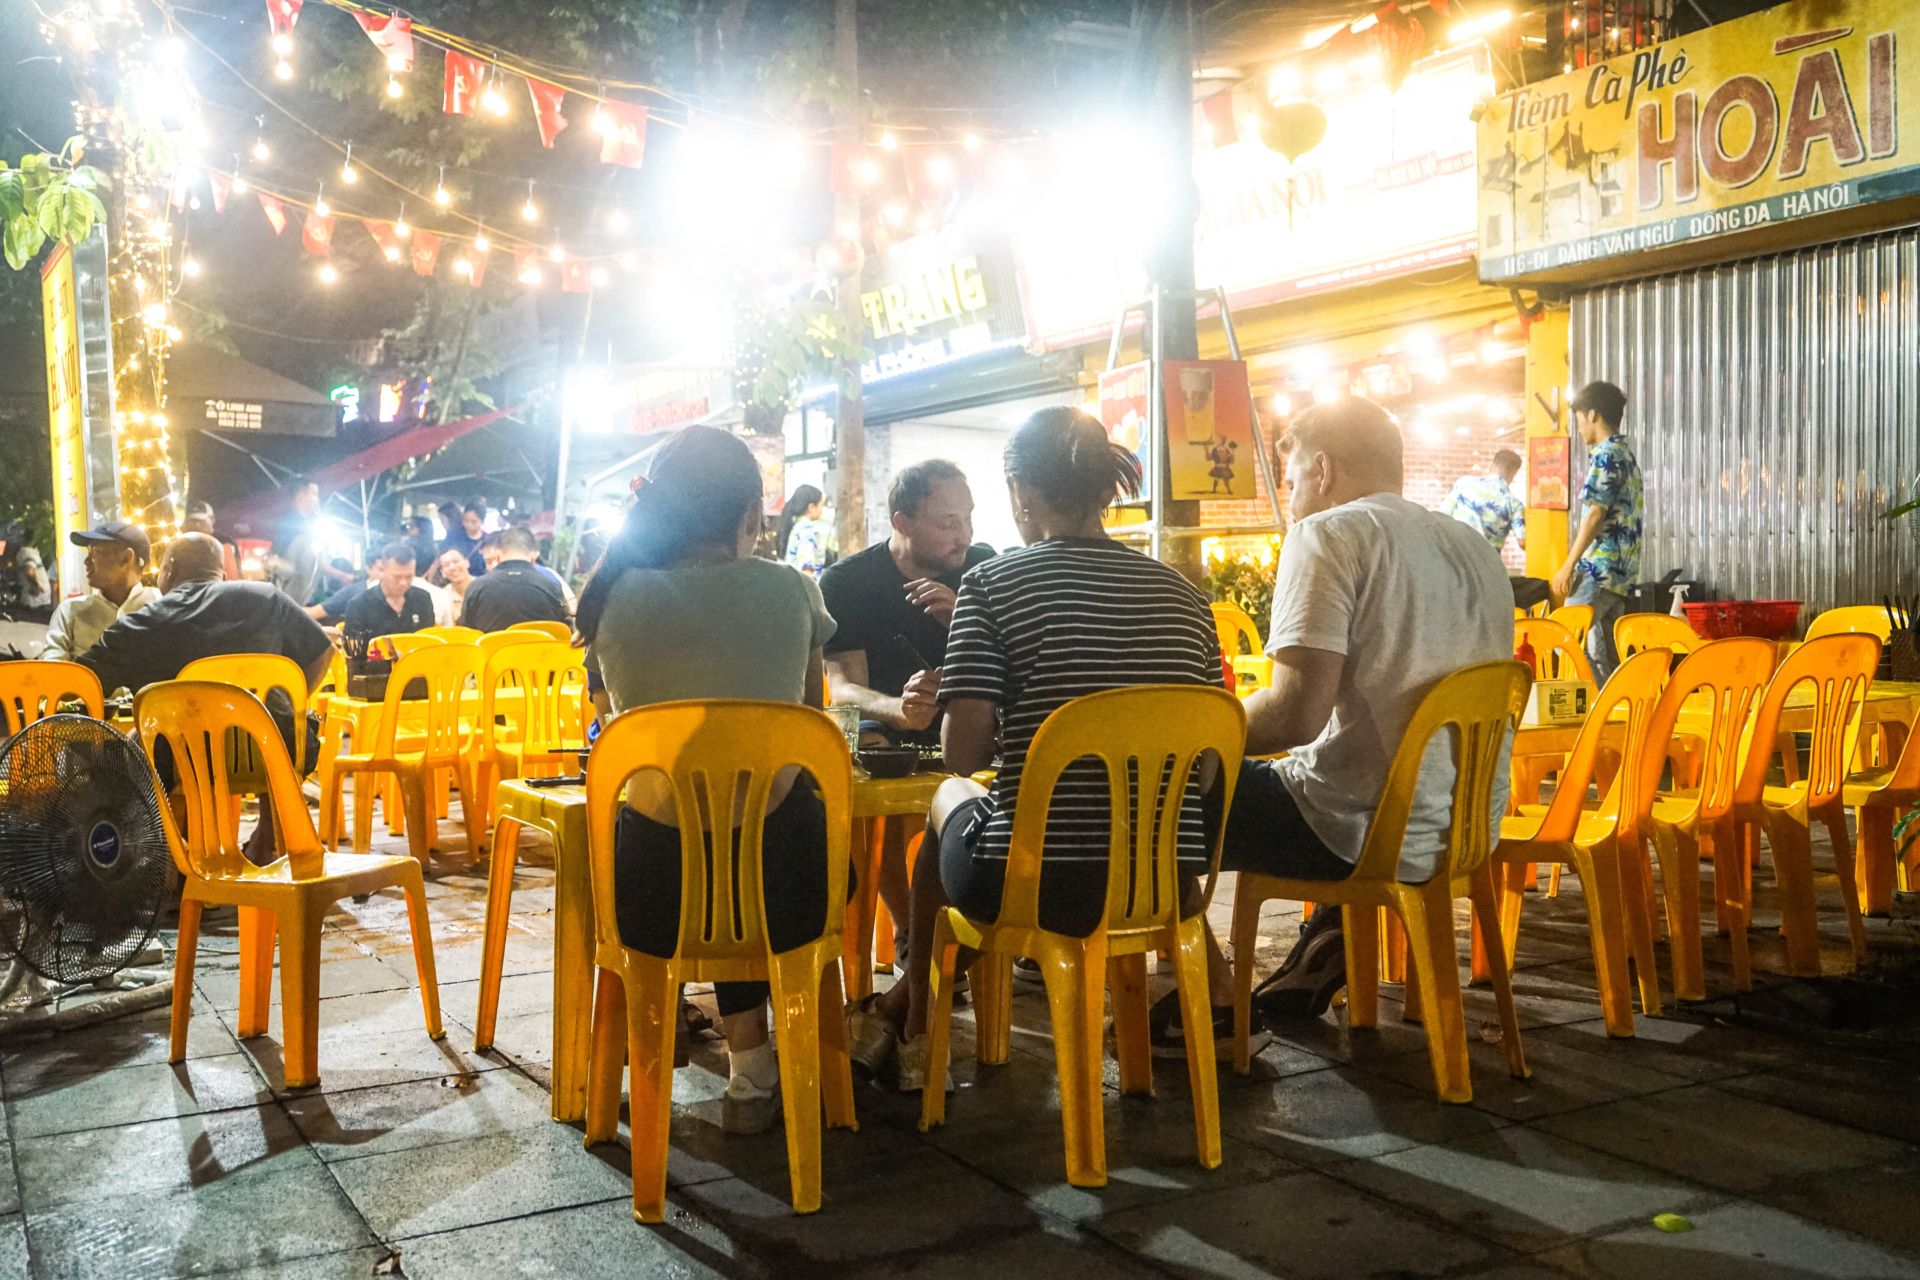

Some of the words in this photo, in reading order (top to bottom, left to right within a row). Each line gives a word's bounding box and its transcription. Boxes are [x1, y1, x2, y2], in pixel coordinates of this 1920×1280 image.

[1585, 65, 1624, 109] Cà
[1625, 45, 1694, 120] Phê
[1744, 202, 1771, 227] ĐA
[1783, 188, 1812, 217] HÀ
[860, 255, 987, 339] TRANG
